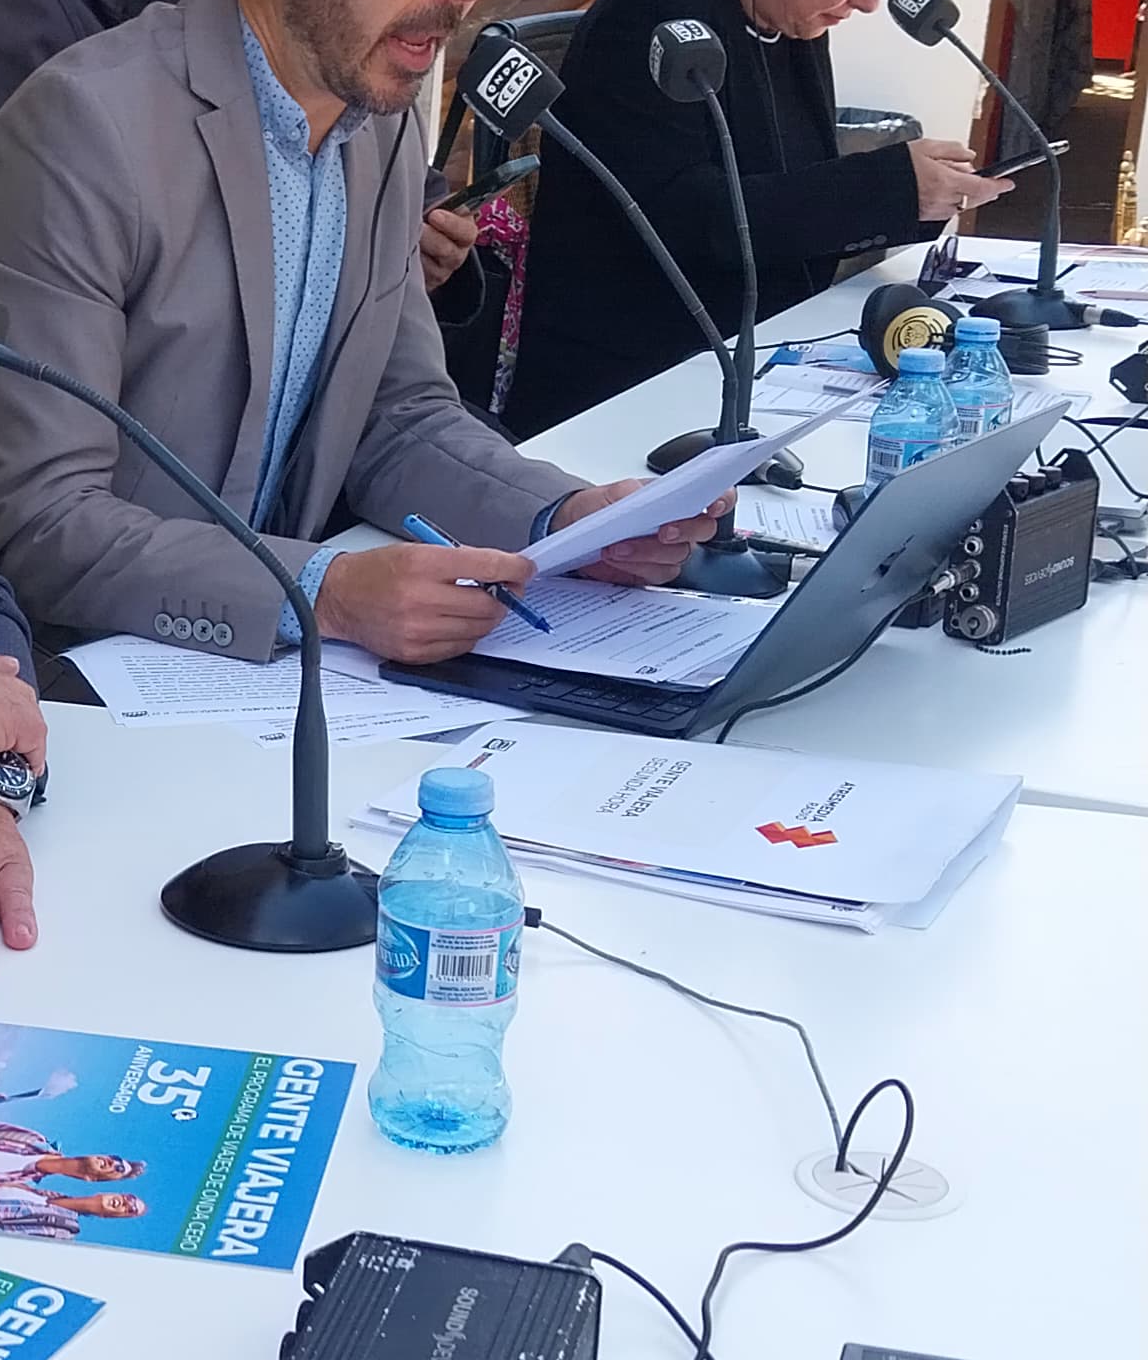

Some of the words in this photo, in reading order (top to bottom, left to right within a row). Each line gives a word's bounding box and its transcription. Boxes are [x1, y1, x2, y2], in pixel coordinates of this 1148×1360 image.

[488, 60, 519, 93] ONDA
[501, 70, 529, 101] CERO
[620, 757, 668, 791] SEGUNDA
[656, 760, 693, 788] GENTE
[596, 788, 631, 814] HORA
[621, 786, 667, 818] VIAJERA
[809, 781, 856, 822] ATRESMEDIA
[109, 1045, 153, 1114] ANIVERSARIO
[256, 1056, 273, 1070] EL
[234, 1071, 269, 1125] PROGRAMA
[258, 1058, 325, 1141] GENTE
[228, 1124, 249, 1140] DE
[214, 1139, 242, 1173] VIAJES
[208, 1172, 227, 1190] DE
[193, 1189, 221, 1221] ONDA
[211, 1147, 296, 1256] VIAJERA
[179, 1219, 207, 1252] CERO
